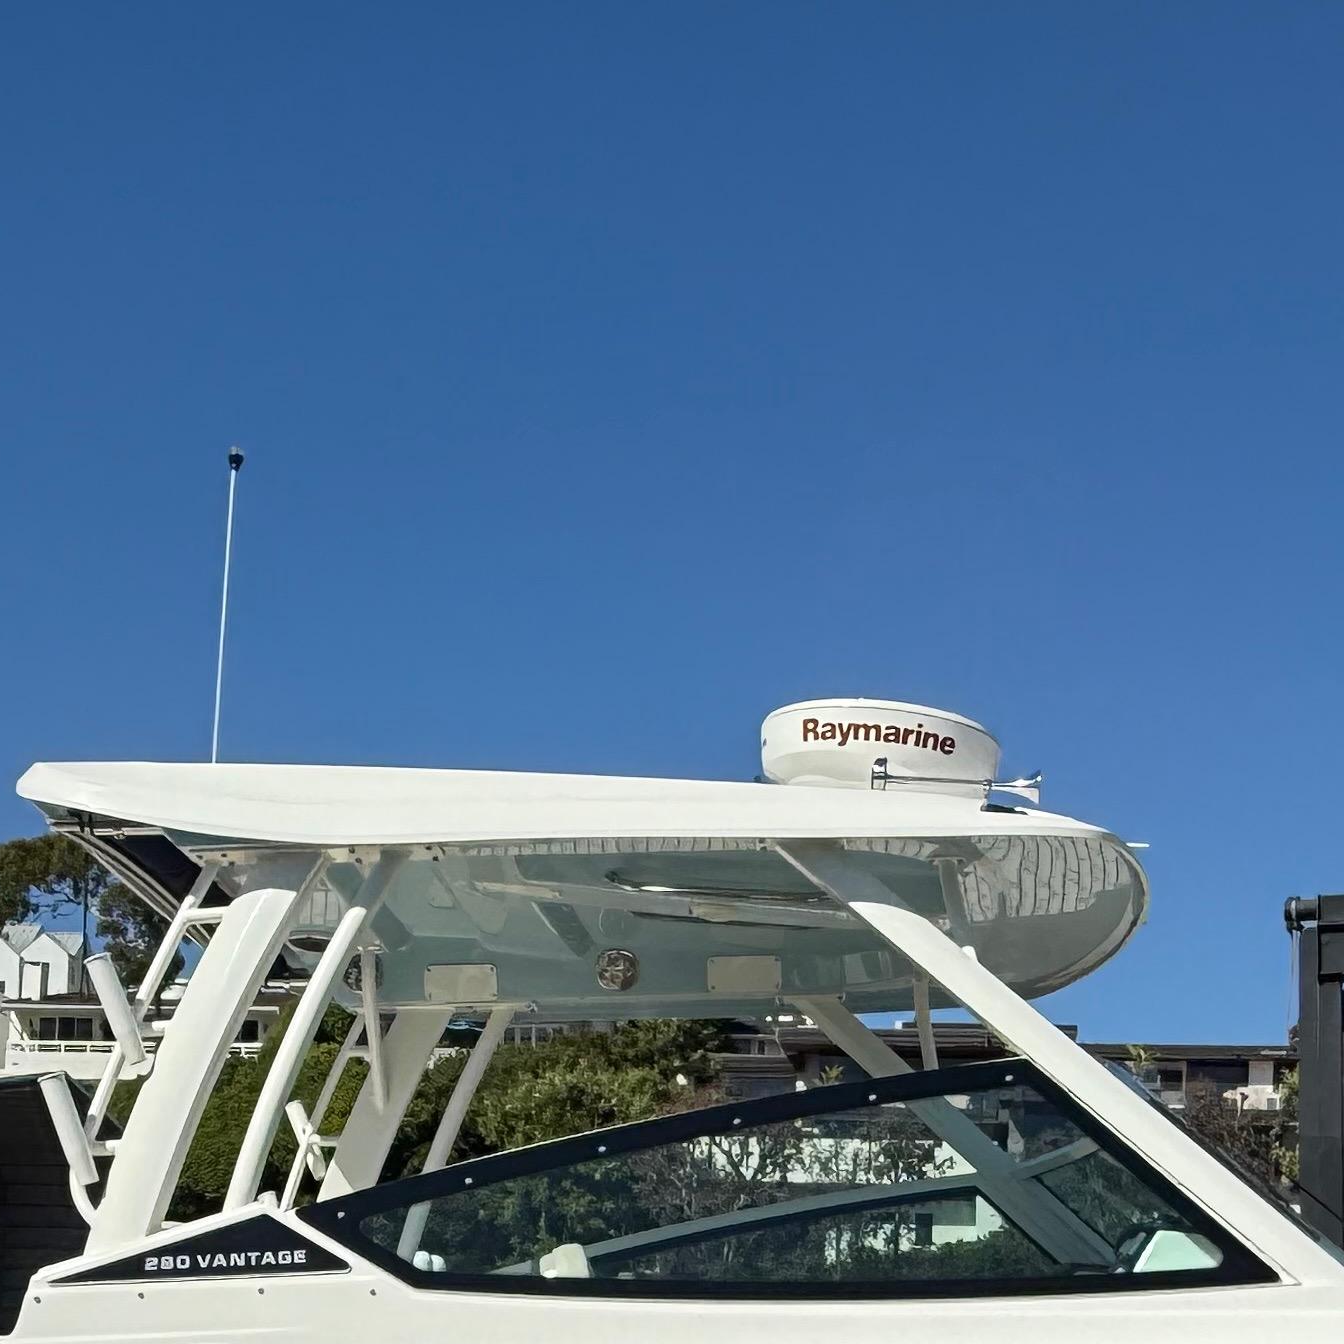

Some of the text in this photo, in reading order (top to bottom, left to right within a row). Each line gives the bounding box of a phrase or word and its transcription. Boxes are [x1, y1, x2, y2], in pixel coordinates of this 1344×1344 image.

[802, 718, 956, 755] Raymarine
[144, 1250, 307, 1271] 280 VANTAGE
